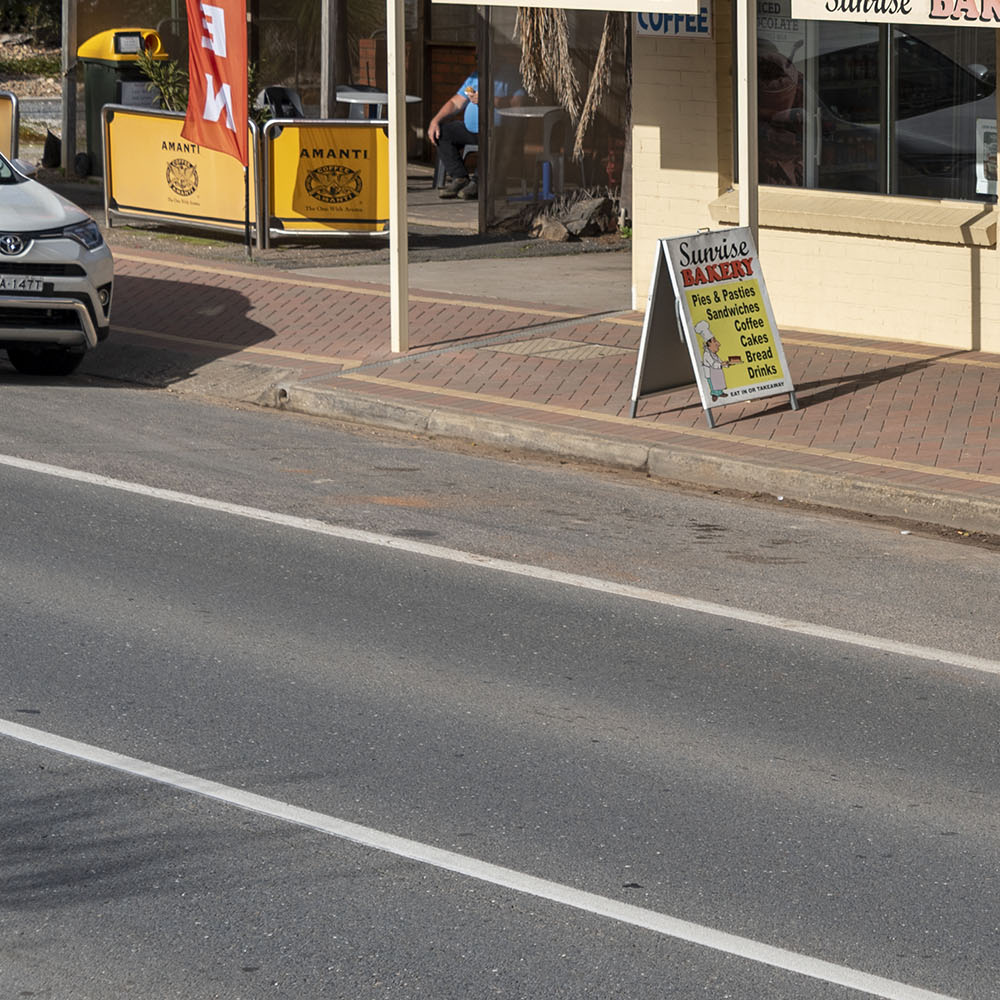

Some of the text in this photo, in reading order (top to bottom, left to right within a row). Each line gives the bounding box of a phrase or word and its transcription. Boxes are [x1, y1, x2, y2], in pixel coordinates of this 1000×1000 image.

[161, 141, 200, 155] AMANTI
[300, 148, 368, 159] AMANTI
[679, 238, 749, 267] Sunrise
[680, 258, 754, 287] BAKERY
[691, 286, 756, 307] Pies & Pasties
[706, 302, 760, 321] Sandwiches
[734, 317, 765, 332] Coffee
[740, 333, 769, 347] Cakes
[745, 347, 773, 363] Bread
[747, 363, 778, 379] Drinks
[757, 381, 785, 391] TAKEAWAY
